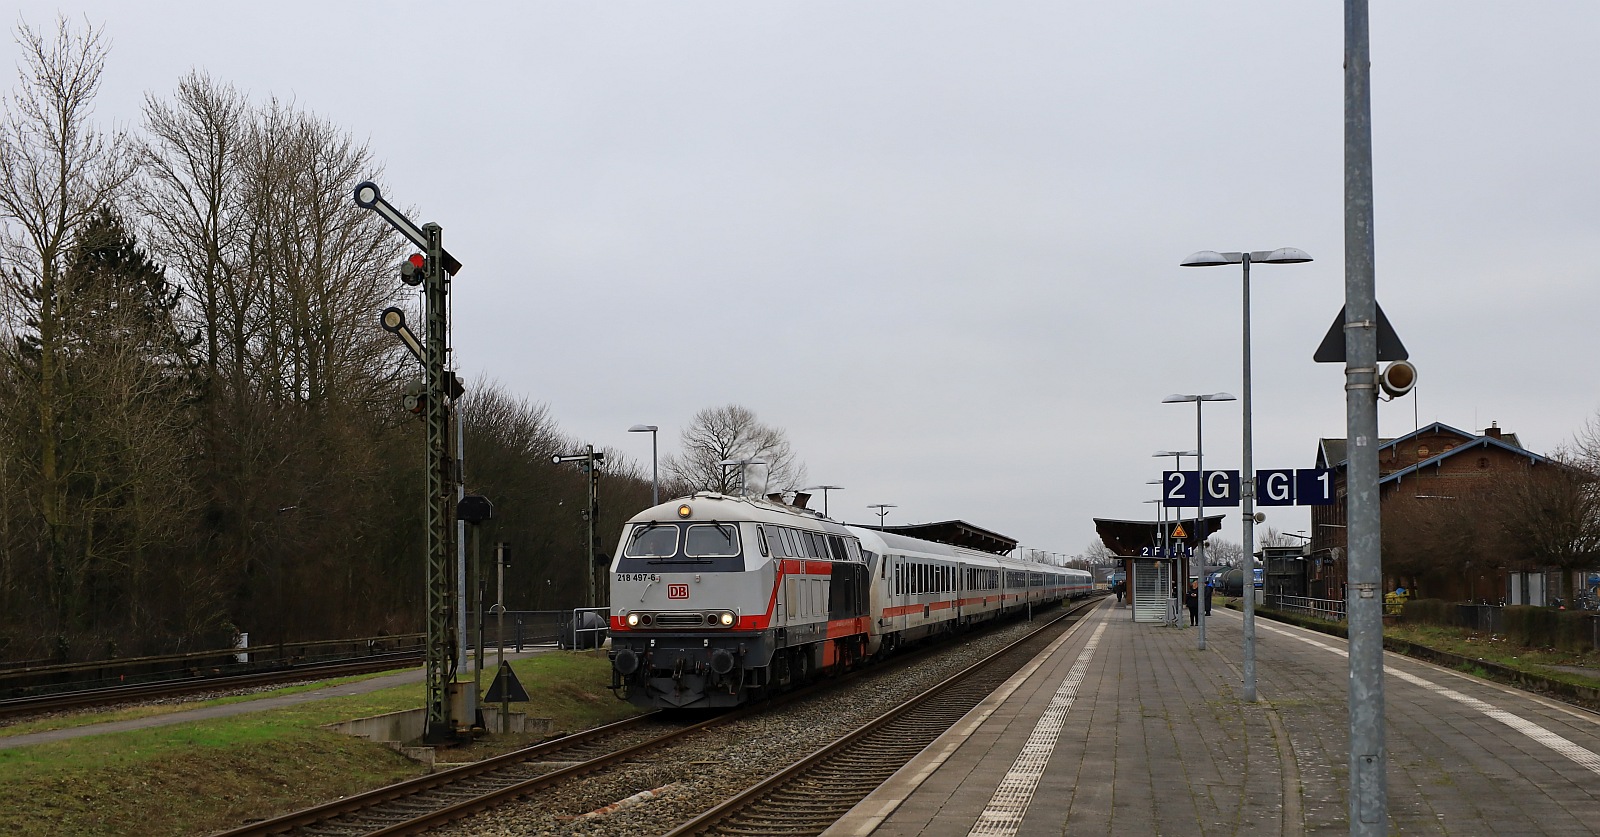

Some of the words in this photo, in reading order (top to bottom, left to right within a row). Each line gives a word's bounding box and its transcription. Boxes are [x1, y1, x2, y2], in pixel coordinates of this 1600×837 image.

[1168, 472, 1186, 499] 2
[1207, 471, 1229, 498] G
[1266, 472, 1289, 500] G
[1317, 472, 1329, 499] 1
[1142, 546, 1149, 556] 2
[1154, 546, 1160, 556] F
[1188, 546, 1194, 556] 1
[617, 574, 631, 582] 218
[633, 574, 656, 582] 497-6
[670, 586, 687, 597] DB
